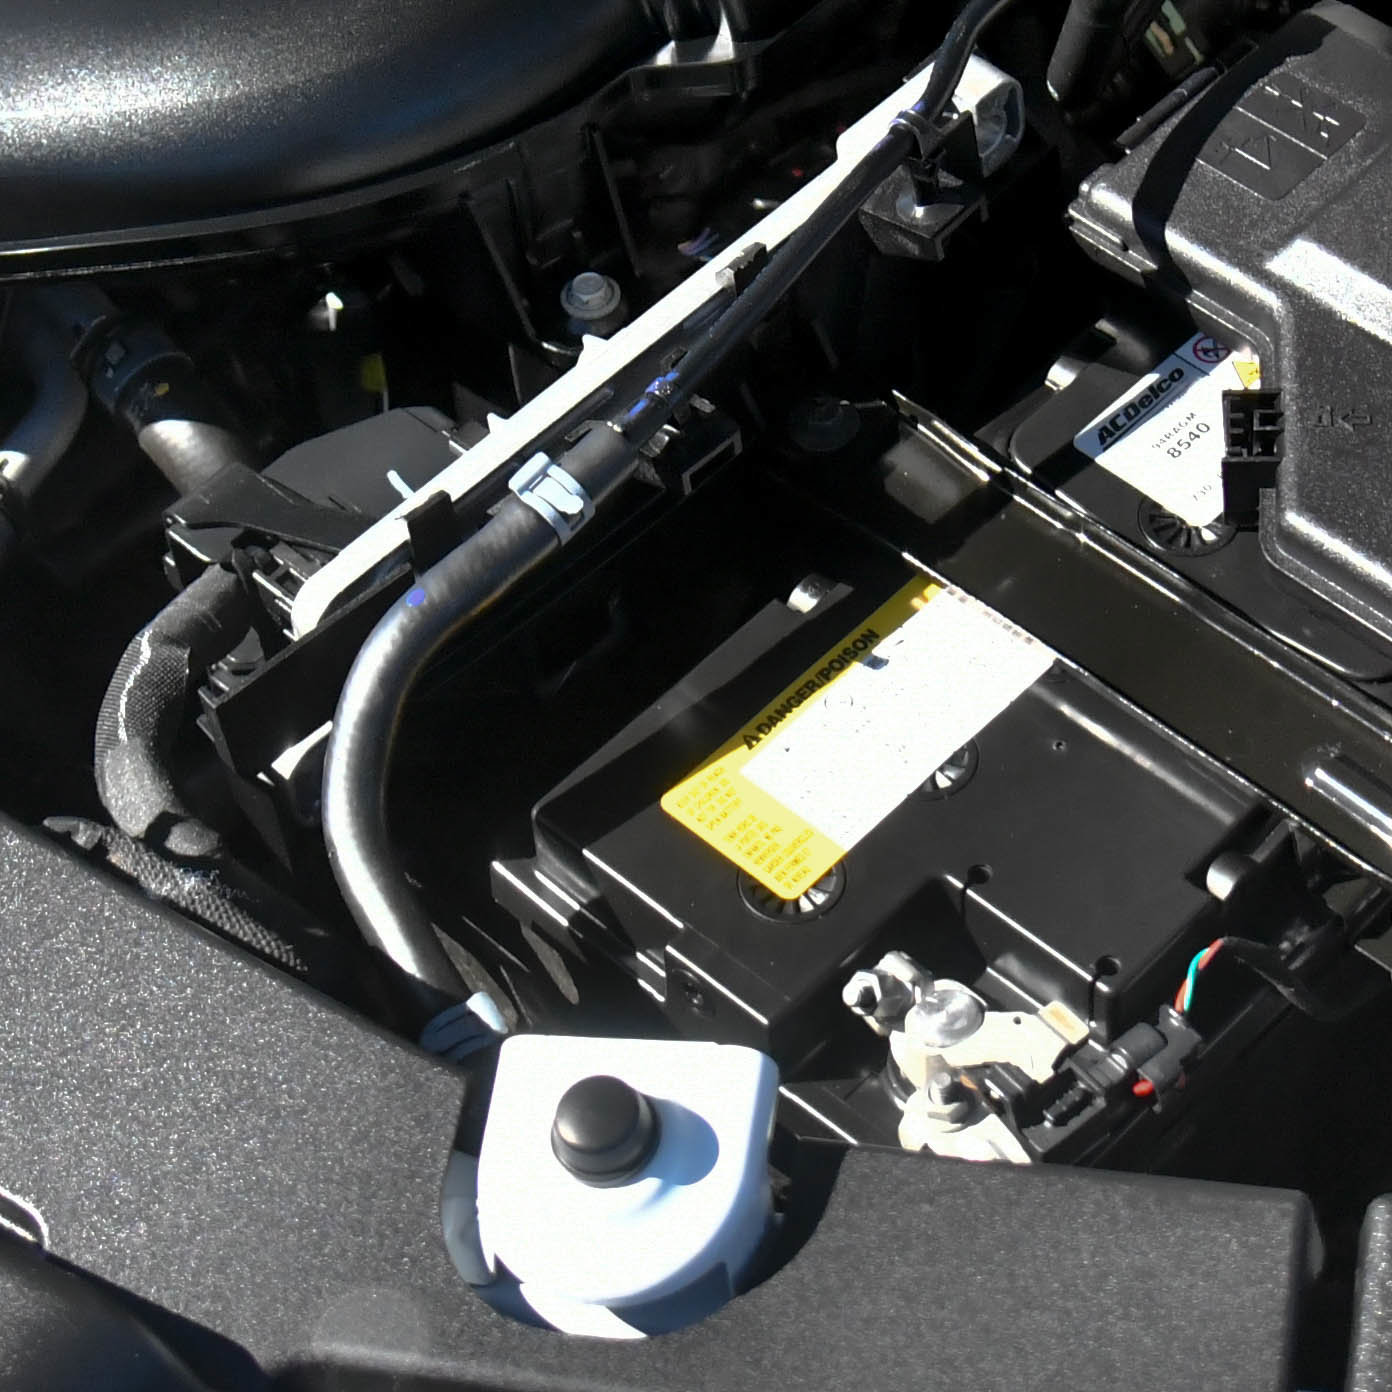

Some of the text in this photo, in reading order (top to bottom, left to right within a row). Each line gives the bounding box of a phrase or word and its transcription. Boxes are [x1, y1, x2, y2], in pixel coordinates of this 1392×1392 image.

[1096, 366, 1185, 446] ACDelco
[1166, 422, 1211, 458] 8540
[757, 628, 881, 737] DANGER/POISON
